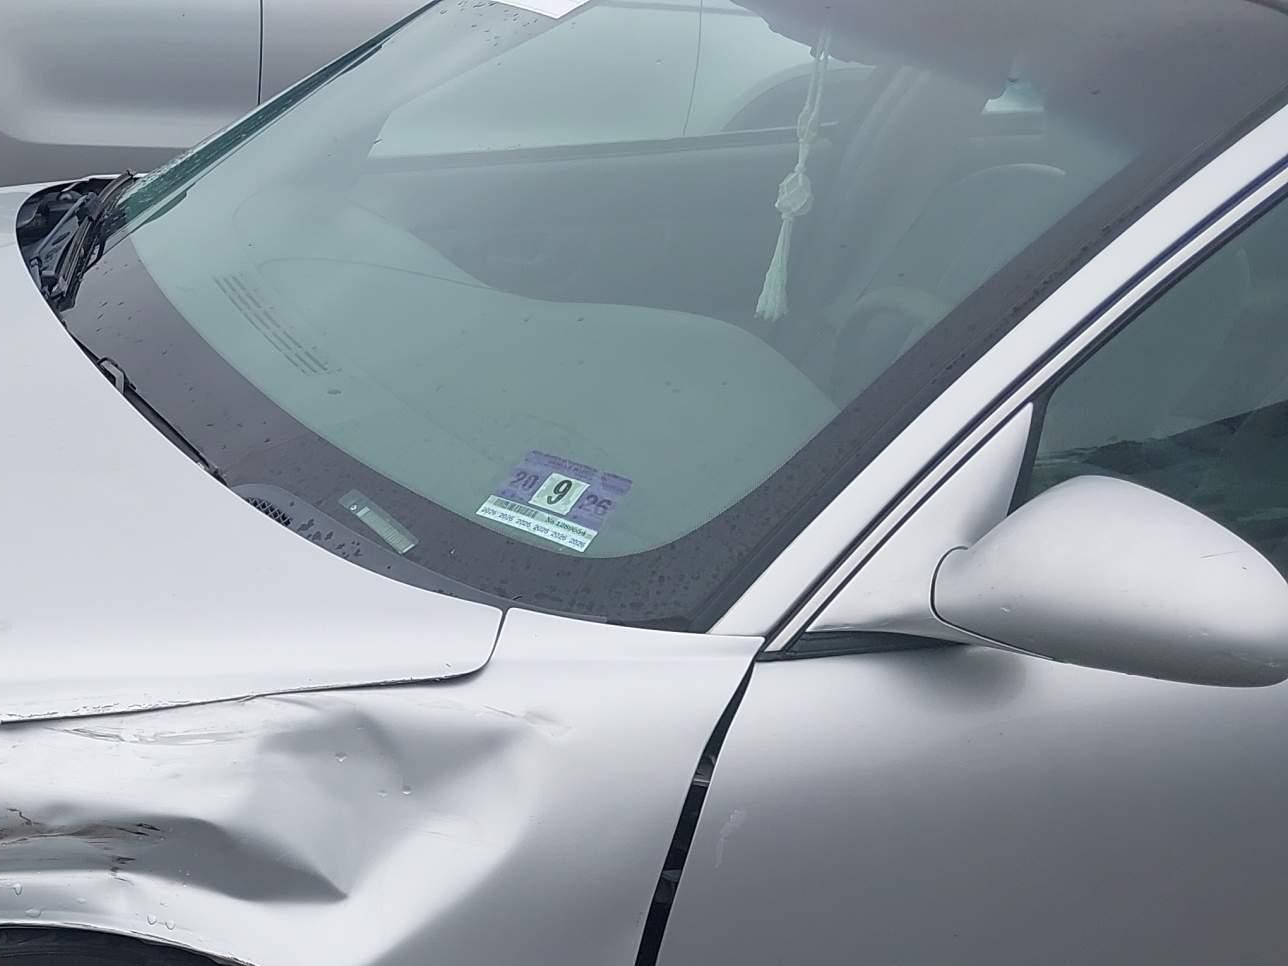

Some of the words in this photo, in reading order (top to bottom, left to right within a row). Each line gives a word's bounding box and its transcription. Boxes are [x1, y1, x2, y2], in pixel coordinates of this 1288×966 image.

[510, 470, 539, 492] 20
[546, 479, 573, 506] 9
[578, 494, 613, 516] 26
